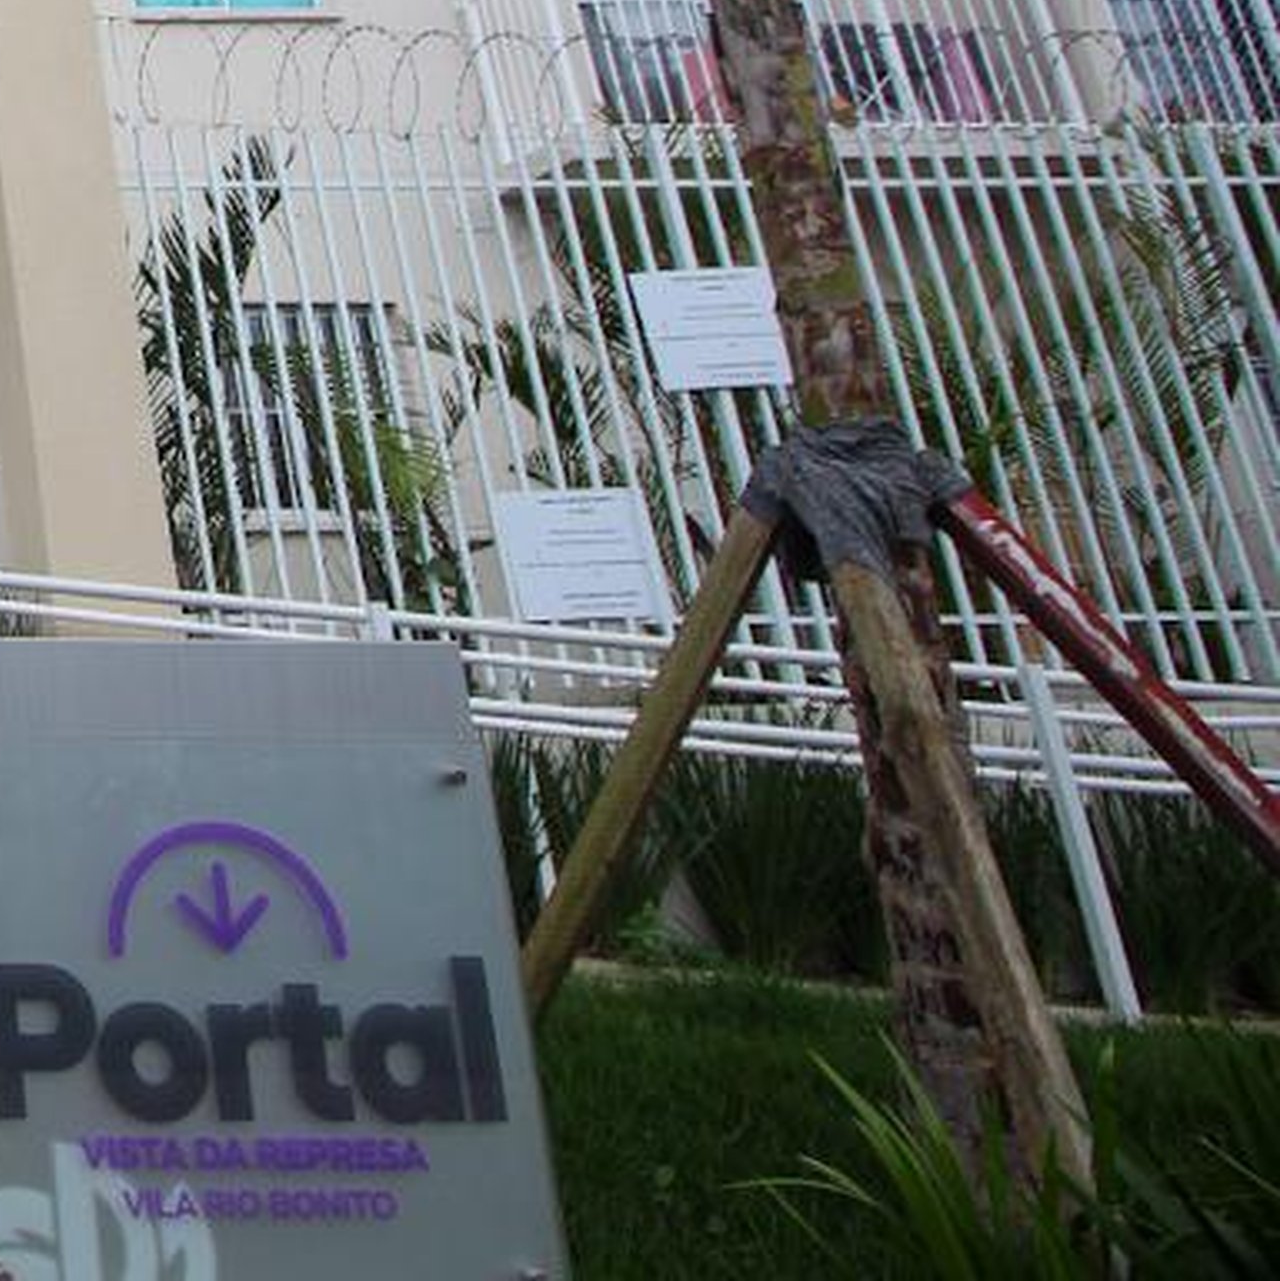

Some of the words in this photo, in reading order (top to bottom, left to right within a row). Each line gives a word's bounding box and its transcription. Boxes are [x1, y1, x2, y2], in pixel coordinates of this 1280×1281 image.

[79, 1136, 188, 1170] VISTA
[194, 1137, 245, 1170] DA
[255, 1137, 430, 1171] REPRESA
[122, 1189, 198, 1220] VILA
[202, 1189, 261, 1220] RIO
[268, 1189, 400, 1221] BONITO
